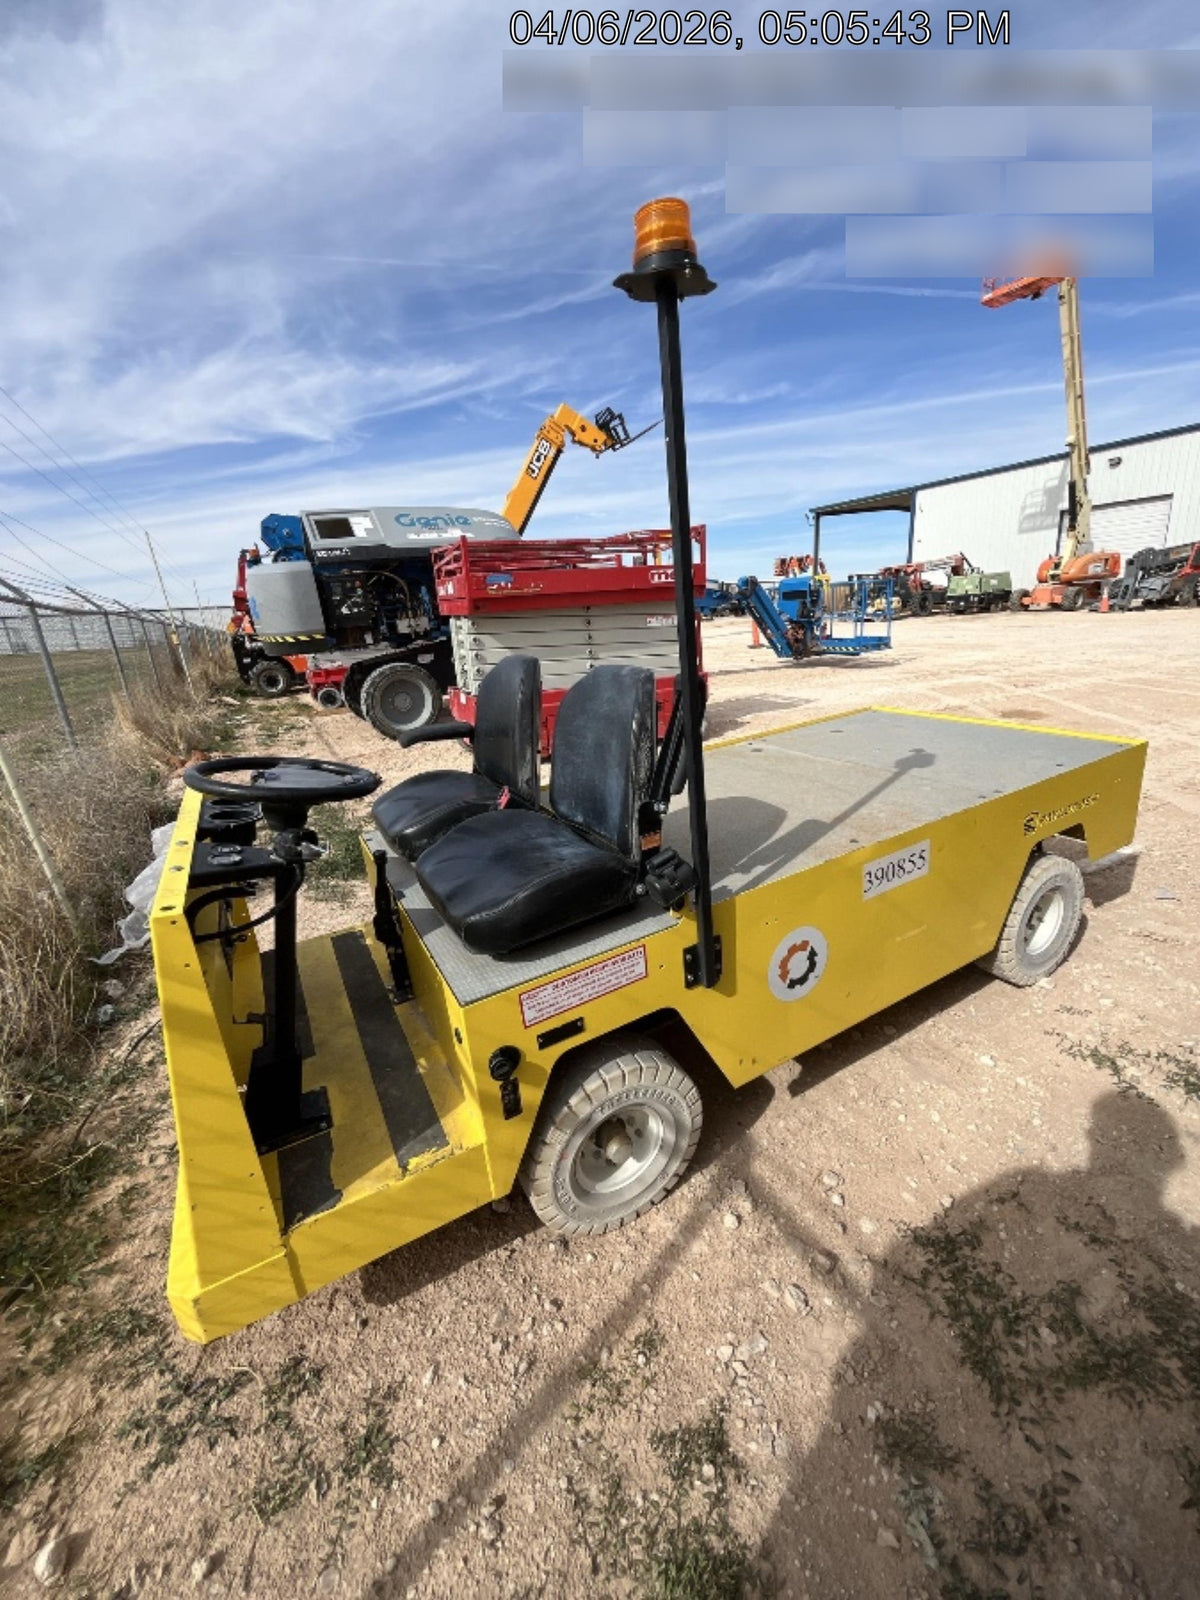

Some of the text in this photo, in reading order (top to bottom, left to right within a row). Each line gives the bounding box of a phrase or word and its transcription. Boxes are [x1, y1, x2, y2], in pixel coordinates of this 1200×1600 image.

[528, 438, 551, 479] JCB
[394, 512, 472, 528] Genie
[863, 849, 927, 894] 390855
